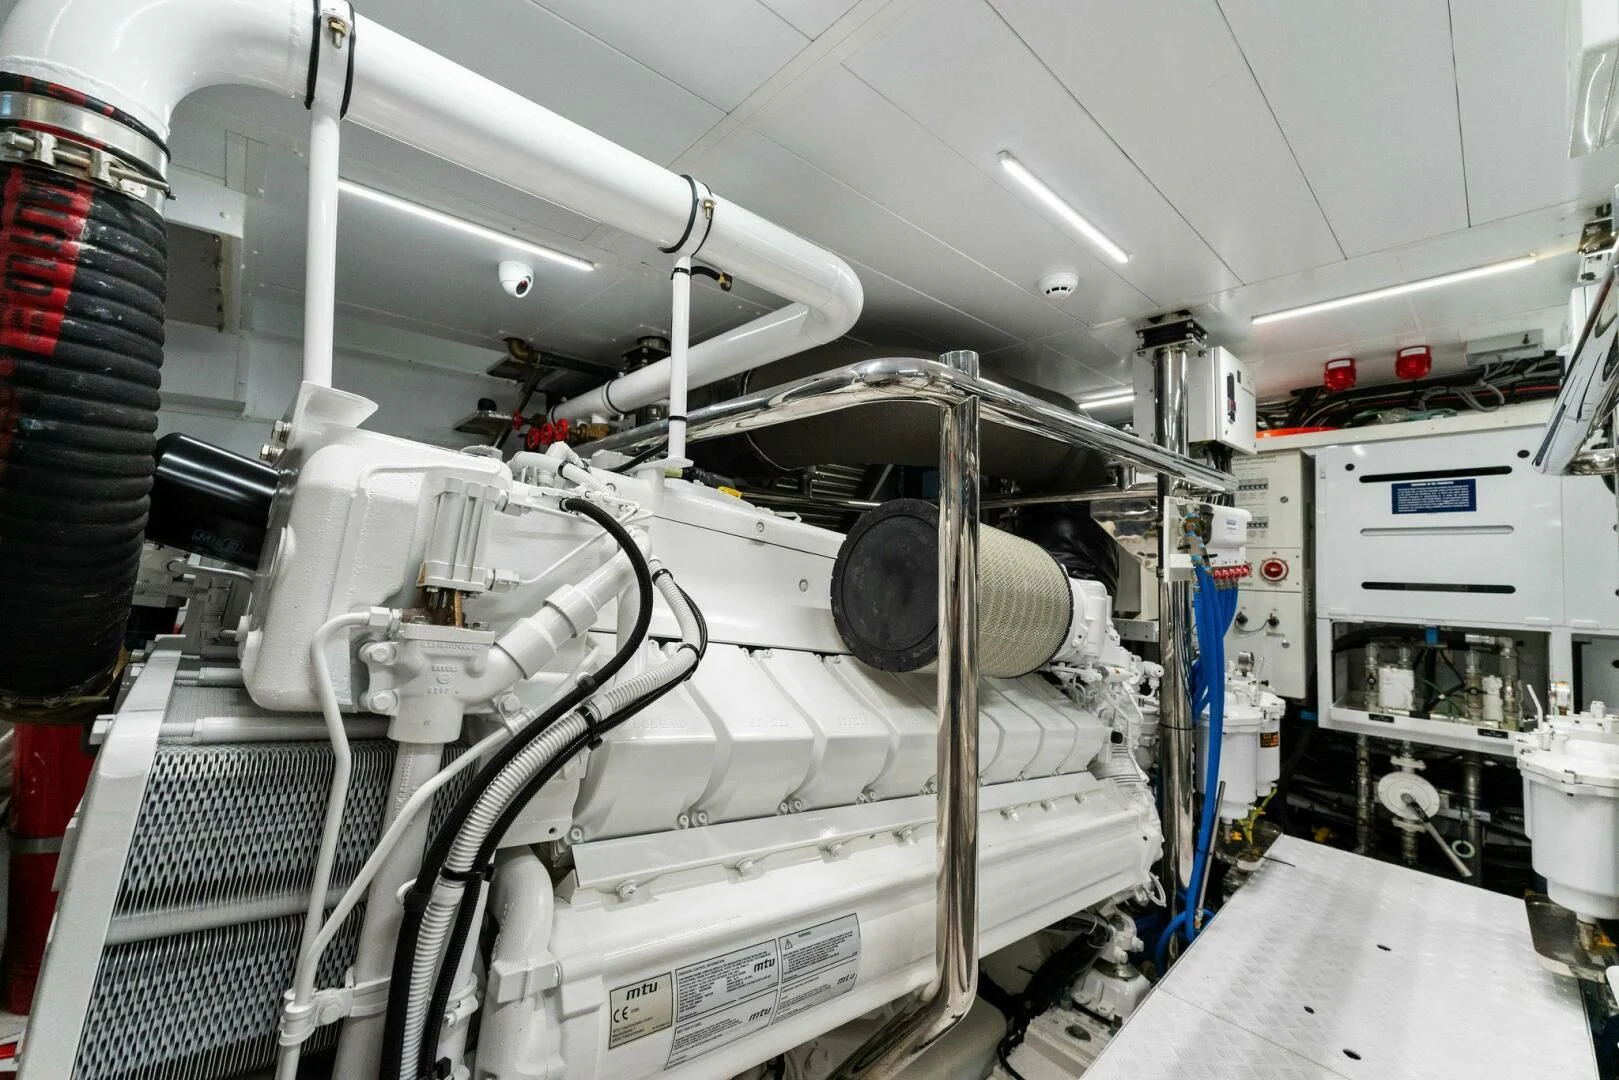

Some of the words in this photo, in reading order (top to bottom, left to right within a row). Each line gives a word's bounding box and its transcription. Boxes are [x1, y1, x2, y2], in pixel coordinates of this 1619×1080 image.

[753, 958, 776, 973] mtu
[837, 972, 856, 986] mtu
[626, 981, 658, 1001] mtu
[748, 1007, 772, 1022] mtu
